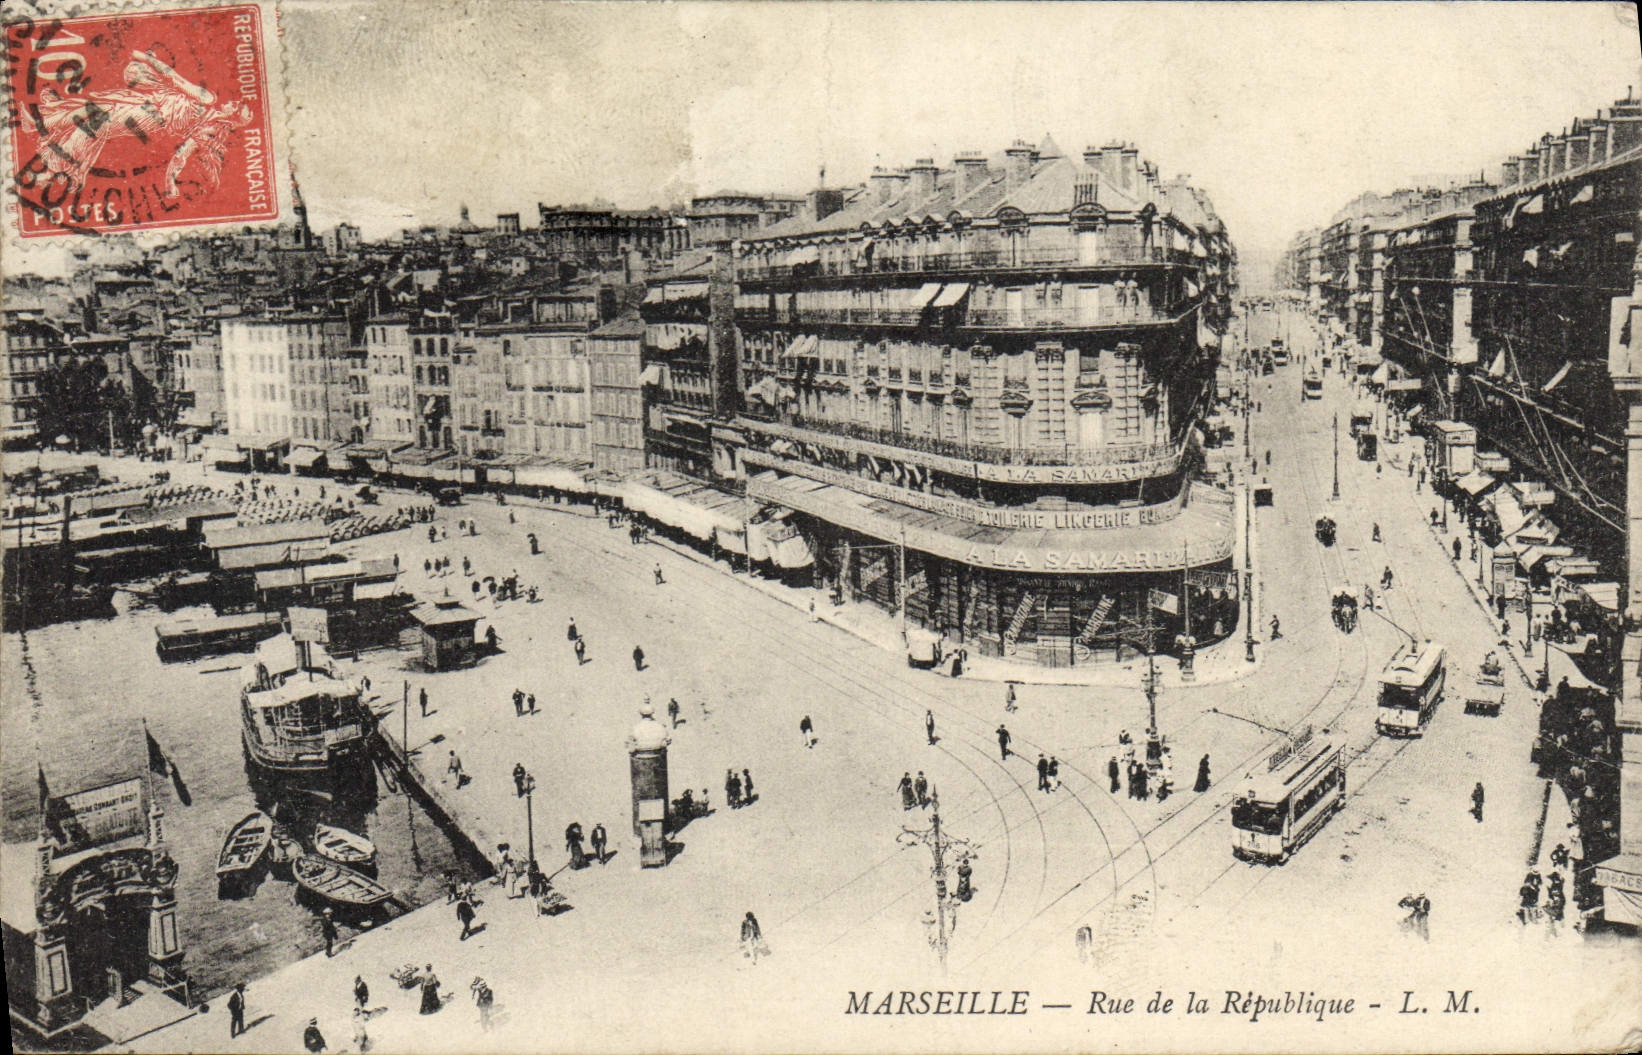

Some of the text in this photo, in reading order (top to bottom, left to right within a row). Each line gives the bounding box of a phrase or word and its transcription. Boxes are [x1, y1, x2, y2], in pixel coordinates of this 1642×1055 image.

[243, 128, 268, 211] FRANÇAISE
[1054, 511, 1131, 529] LINGERIE
[965, 546, 984, 565] A
[991, 550, 1032, 568] LA
